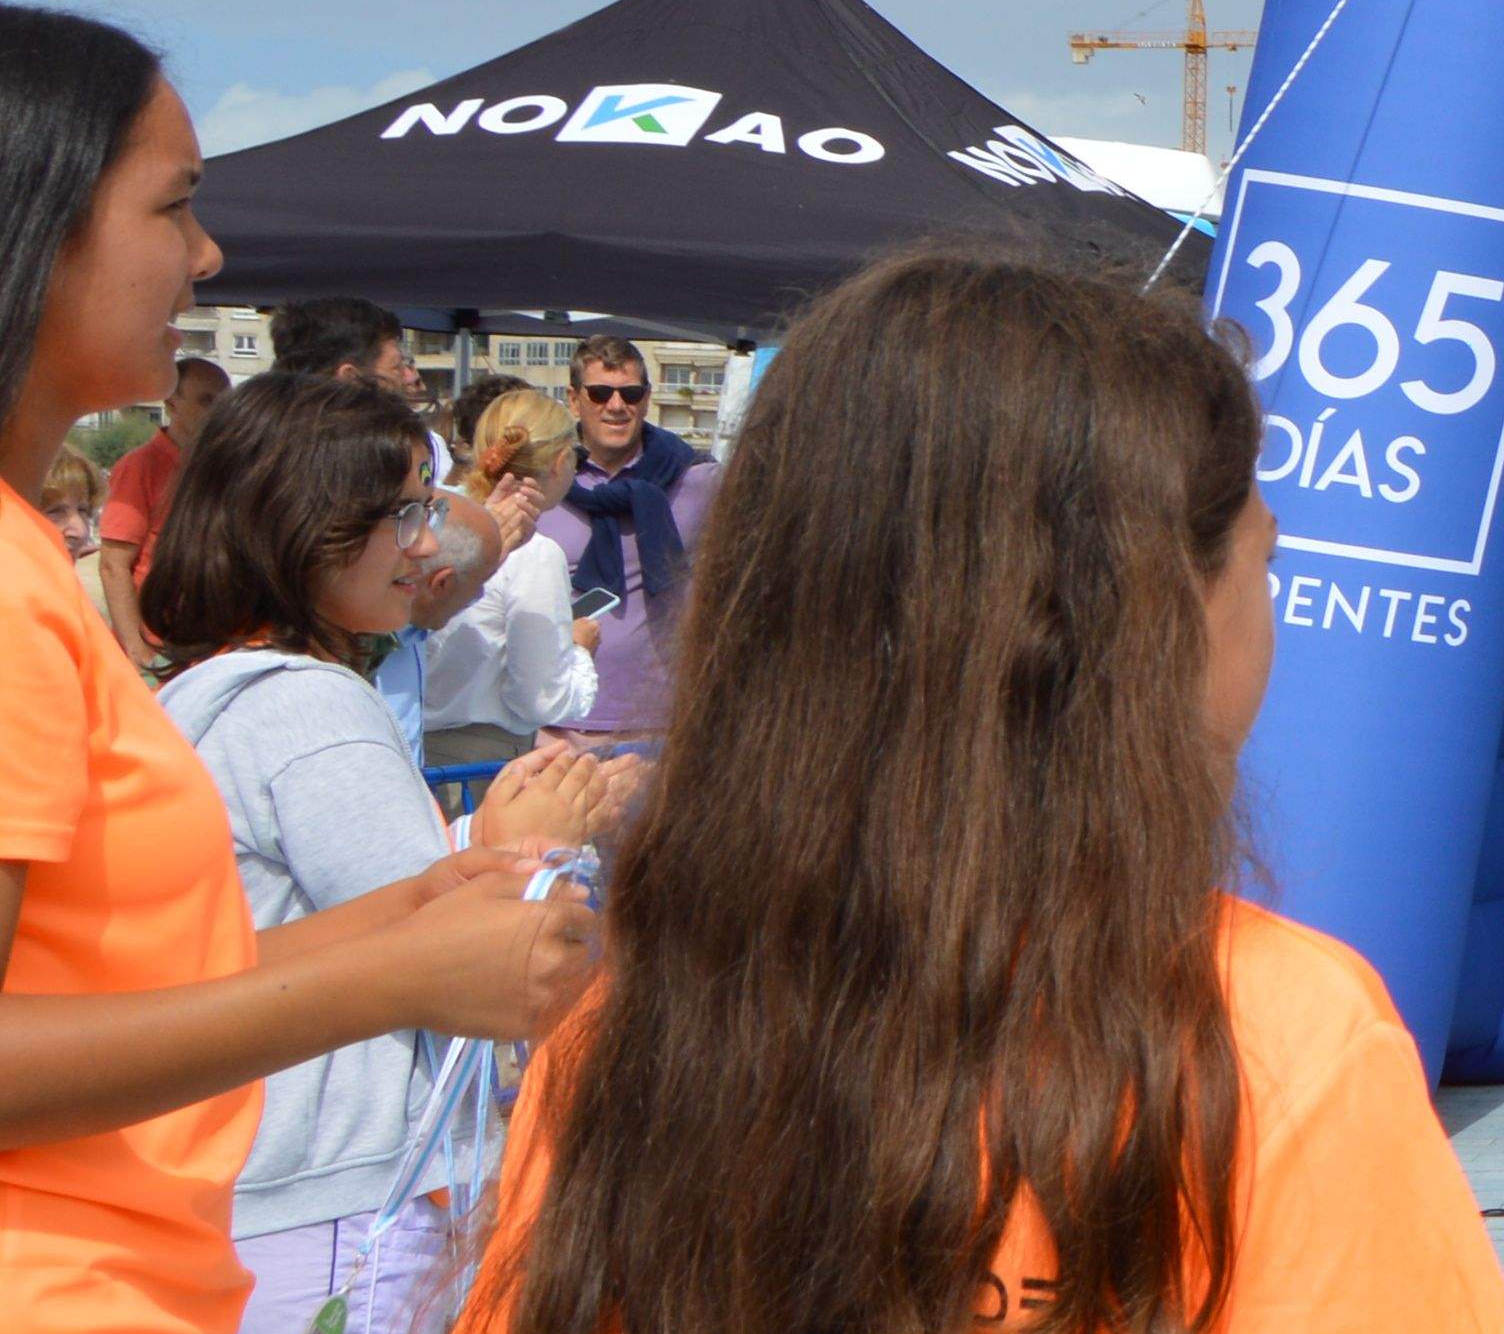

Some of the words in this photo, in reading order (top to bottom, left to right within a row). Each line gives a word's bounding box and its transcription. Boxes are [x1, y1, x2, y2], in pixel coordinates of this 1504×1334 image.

[380, 83, 886, 164] NOKAO
[1245, 240, 1504, 415] 365
[1255, 407, 1427, 503] DÍAS
